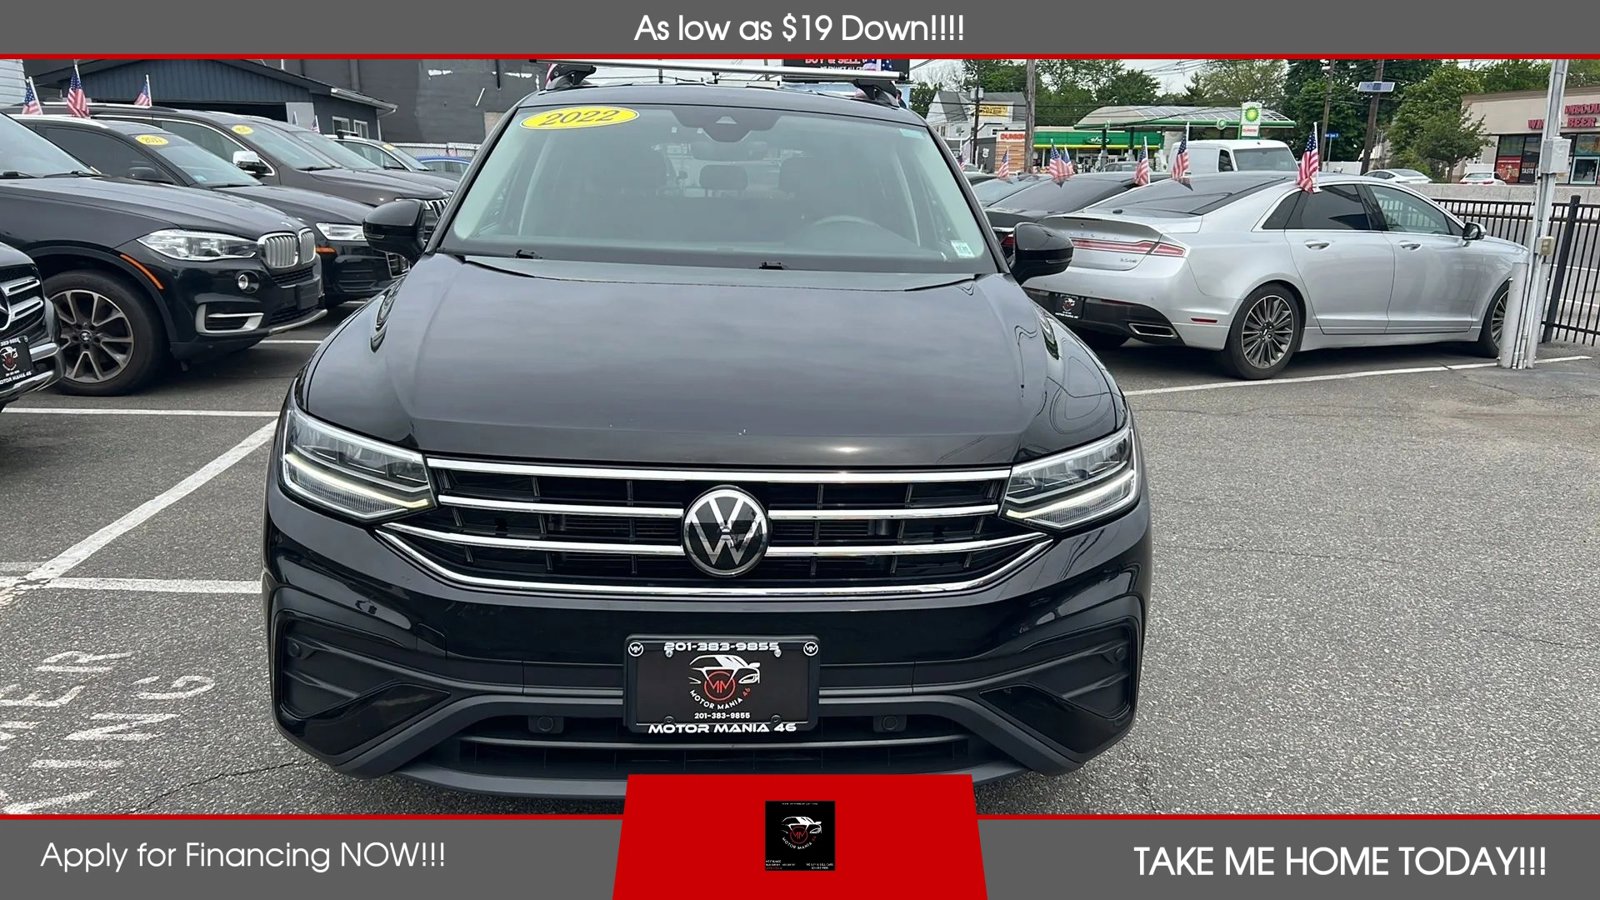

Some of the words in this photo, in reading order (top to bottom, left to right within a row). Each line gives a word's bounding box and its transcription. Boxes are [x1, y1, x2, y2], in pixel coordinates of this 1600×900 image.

[538, 110, 620, 126] 2022
[1567, 117, 1596, 129] BEER
[663, 641, 780, 651] 201-383-9855
[689, 689, 715, 710] MOTOR
[717, 697, 743, 710] MANIA
[694, 711, 751, 719] 201-383-9855
[648, 723, 709, 734] MOTOR
[713, 723, 770, 733] MANIA
[773, 722, 797, 732] 46
